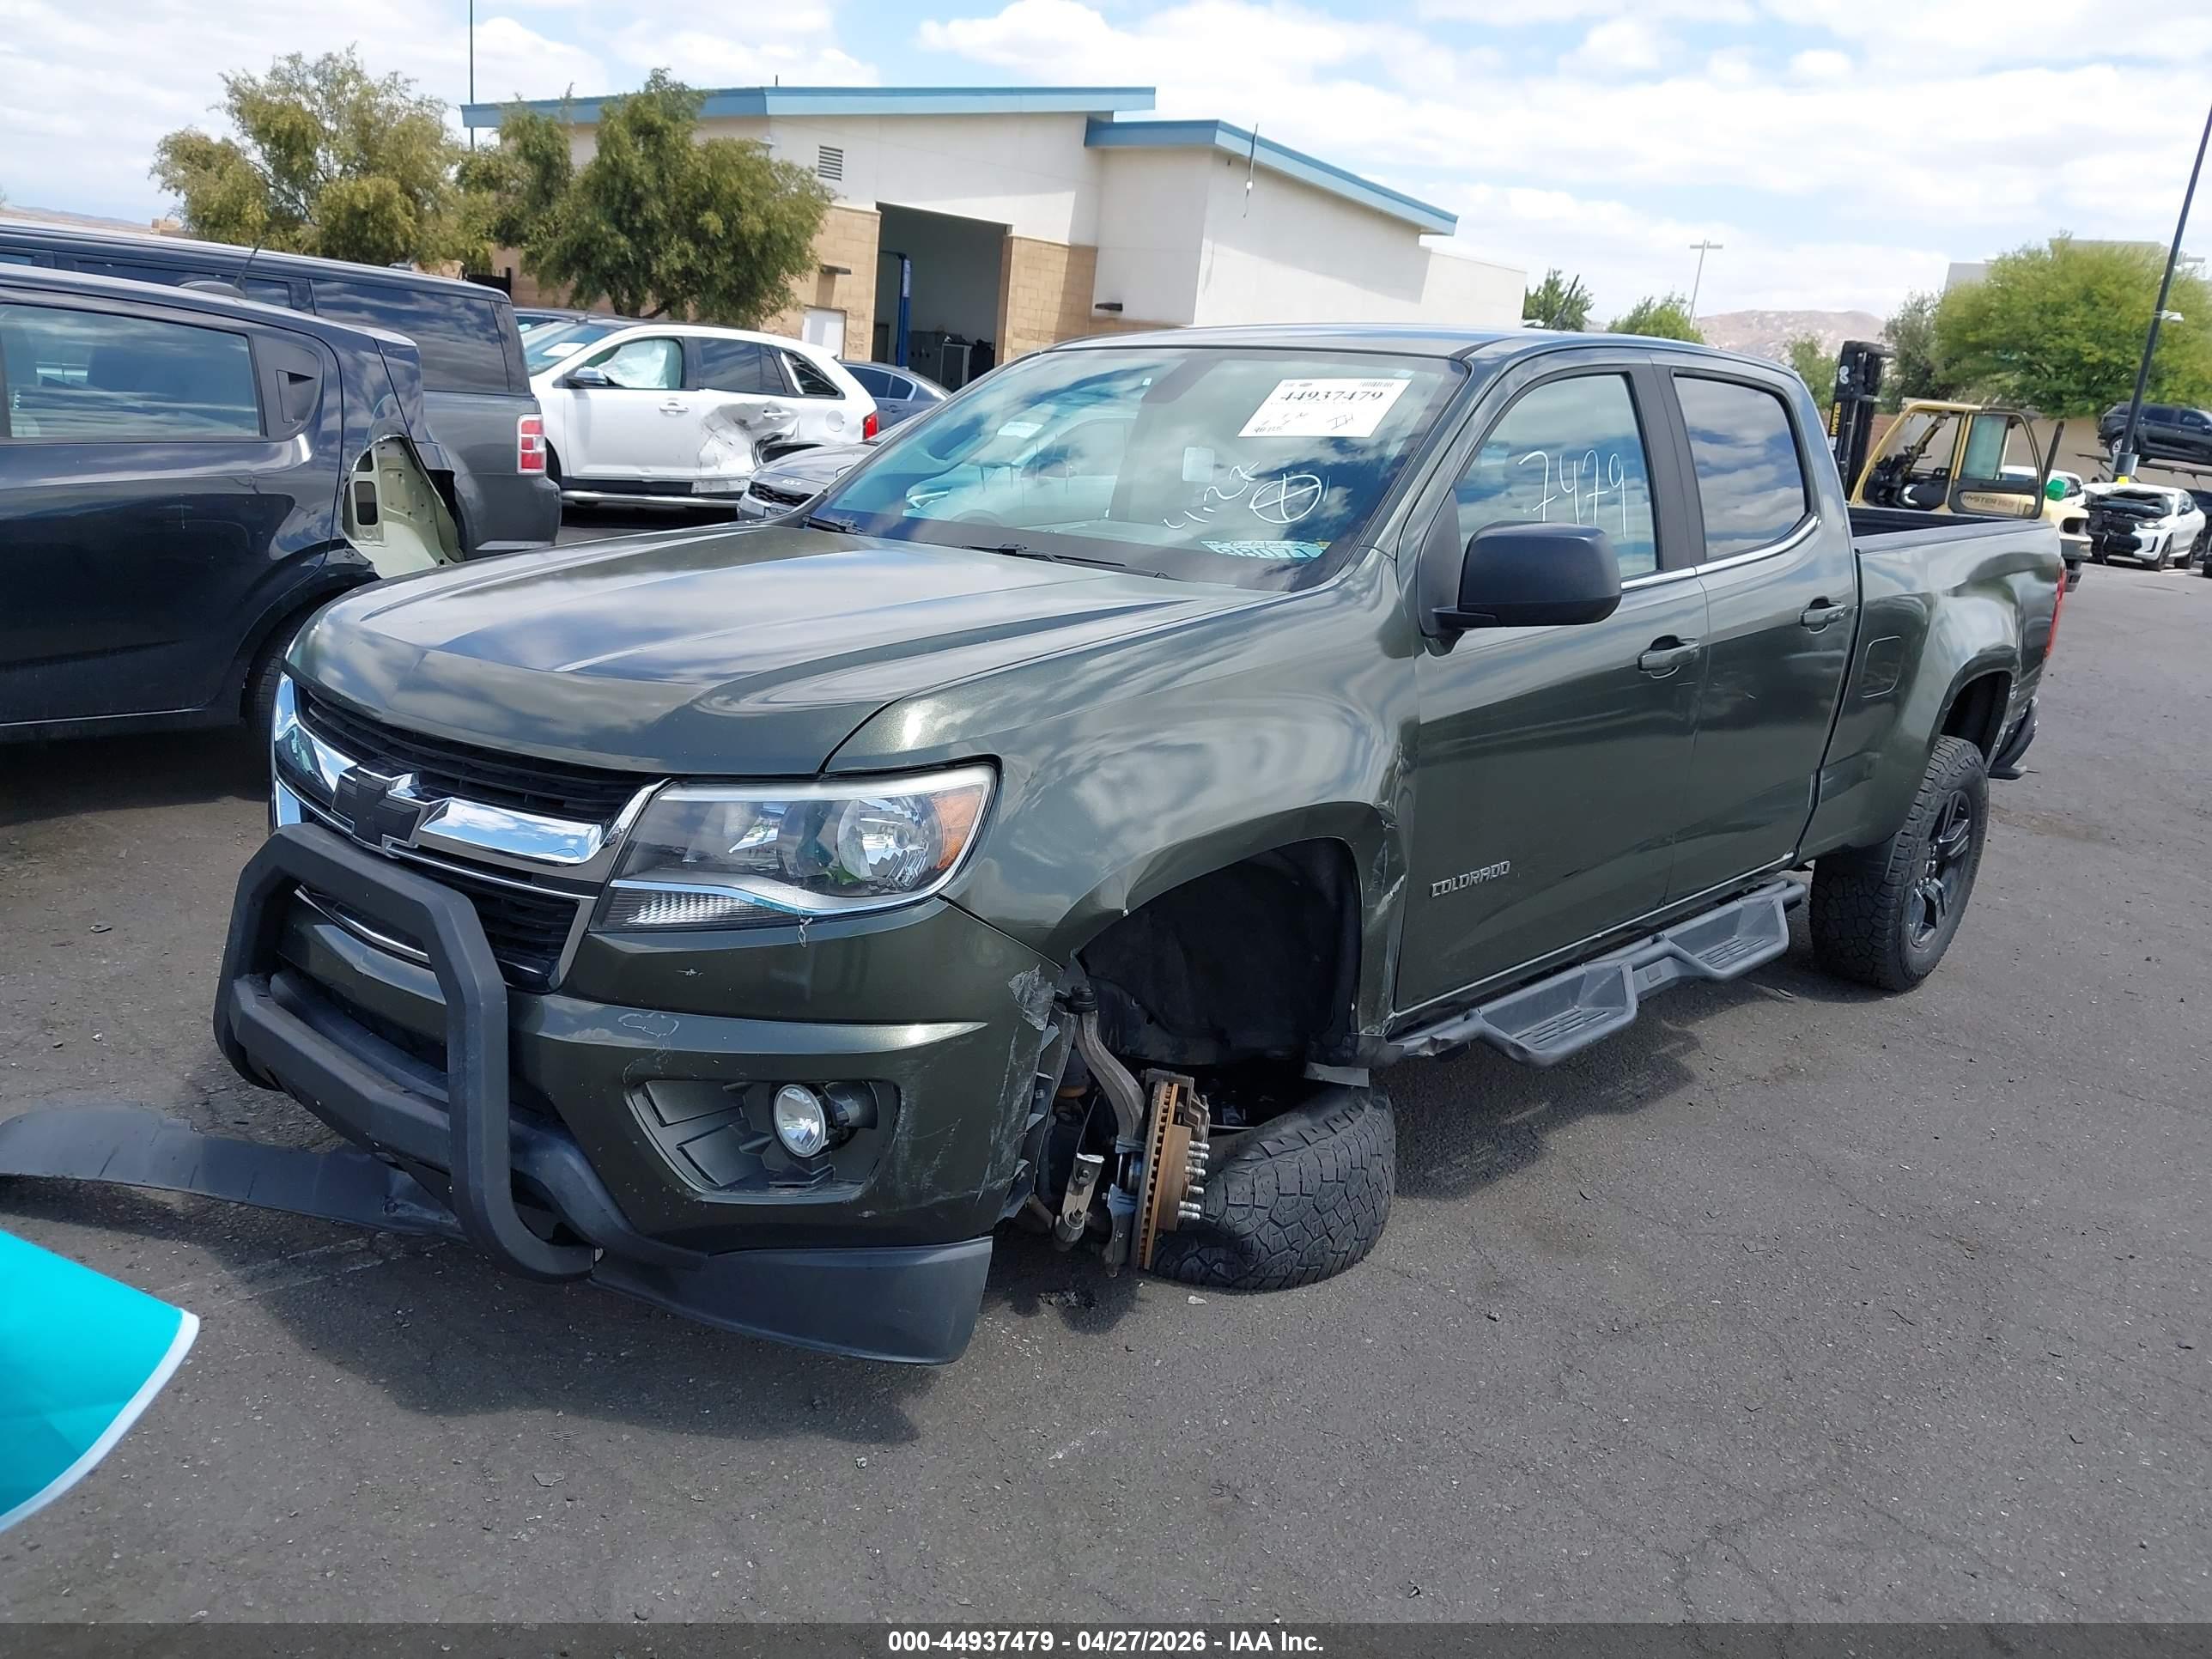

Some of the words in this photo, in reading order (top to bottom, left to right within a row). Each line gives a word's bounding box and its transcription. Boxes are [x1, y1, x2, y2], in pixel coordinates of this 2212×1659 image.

[1280, 391, 1383, 402] 44937479
[1830, 402, 1841, 435] HYSTER
[1518, 449, 1626, 538] 7479
[1430, 860, 1510, 898] COLORADO
